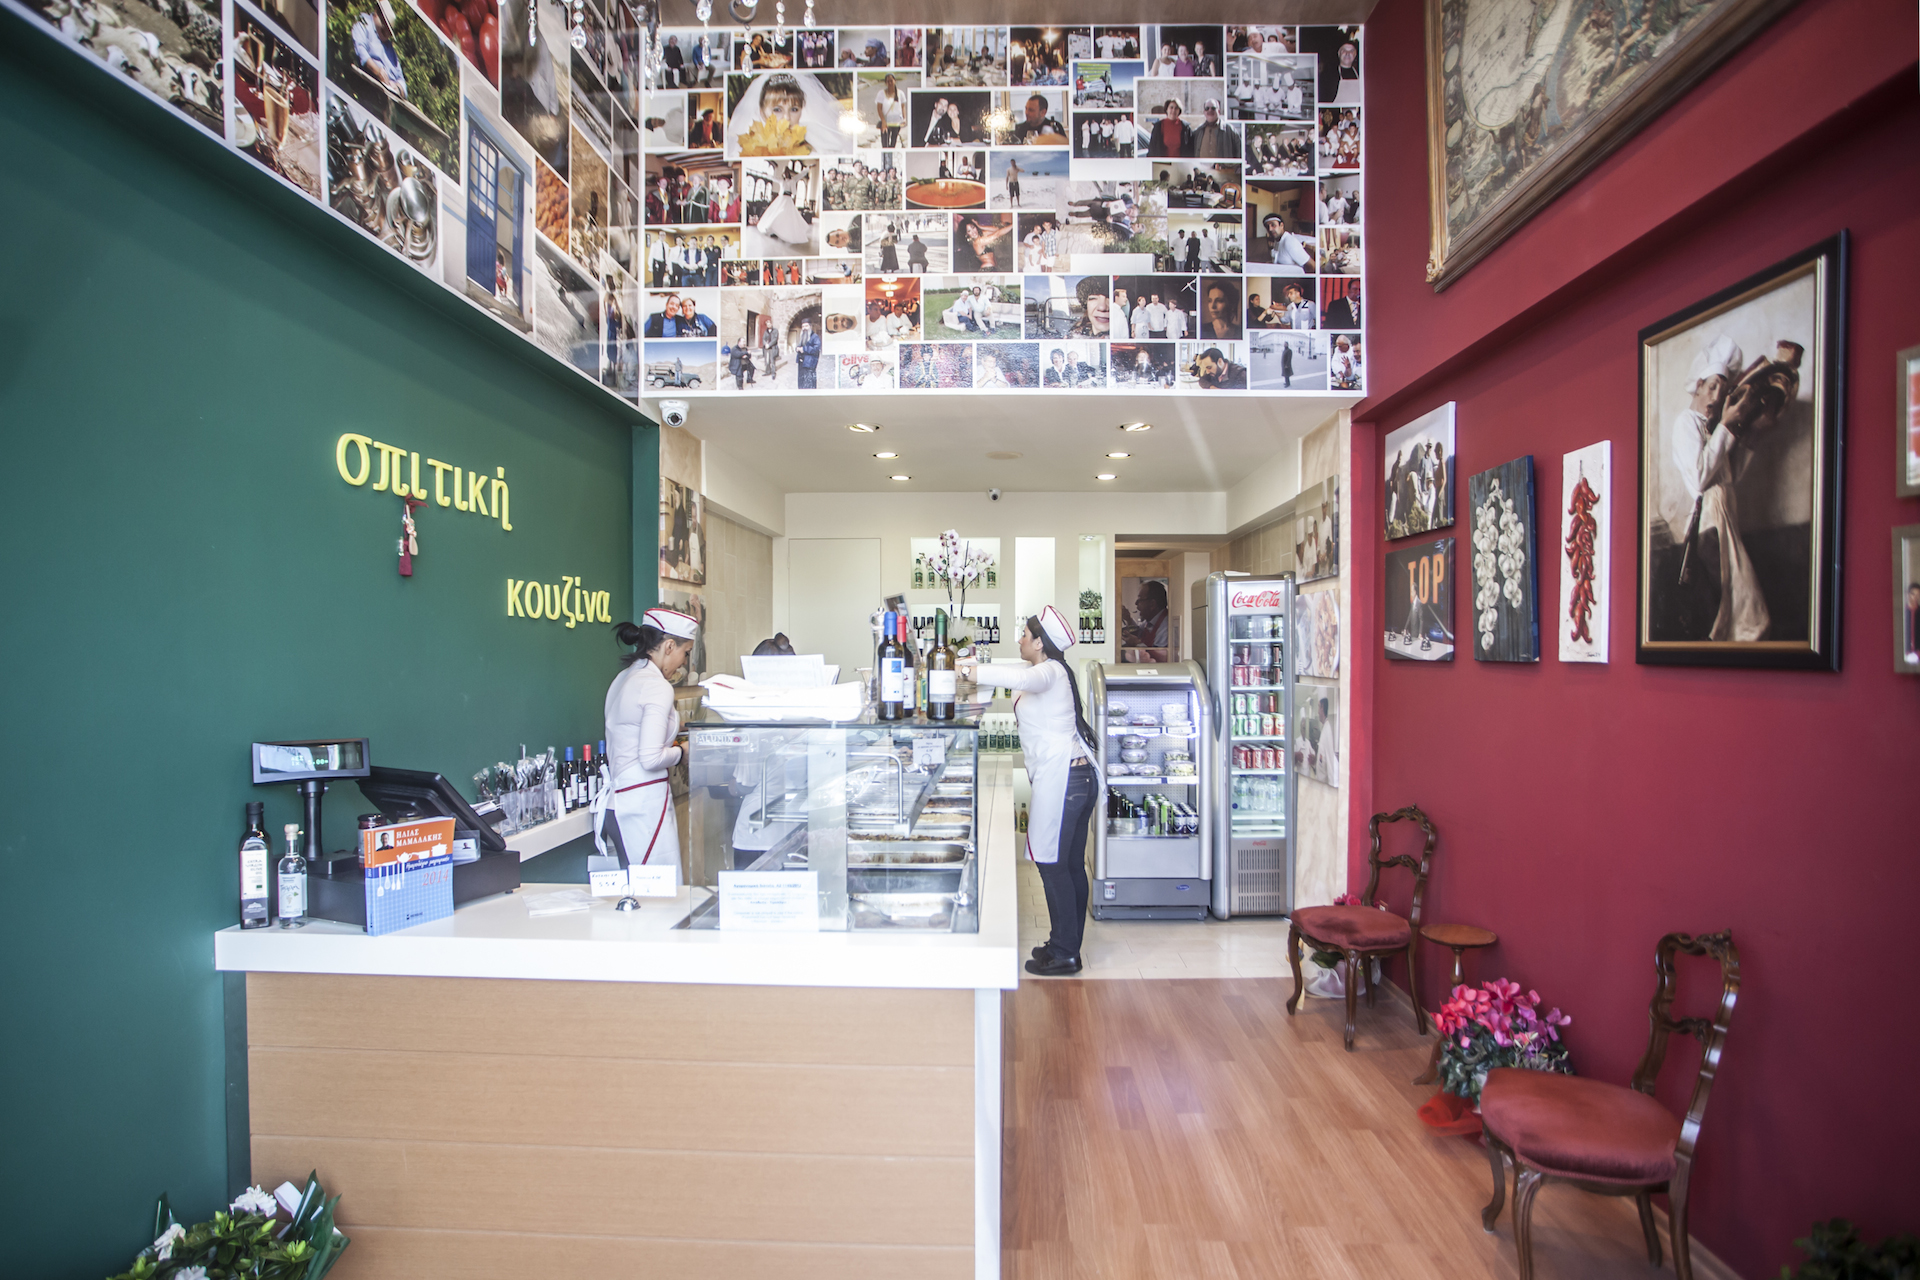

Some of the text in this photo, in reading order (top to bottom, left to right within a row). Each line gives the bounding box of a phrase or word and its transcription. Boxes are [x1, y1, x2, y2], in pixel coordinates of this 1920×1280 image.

[336, 432, 513, 531] σπιτική
[1407, 553, 1445, 604] TOP
[507, 575, 612, 629] κουζίνα
[1231, 590, 1282, 609] Coca-Cola
[396, 828, 419, 839] ΗΛΙΑΣ
[396, 833, 443, 848] ΜΑΜΑΛΑΚΗΣ
[422, 868, 449, 887] 2014
